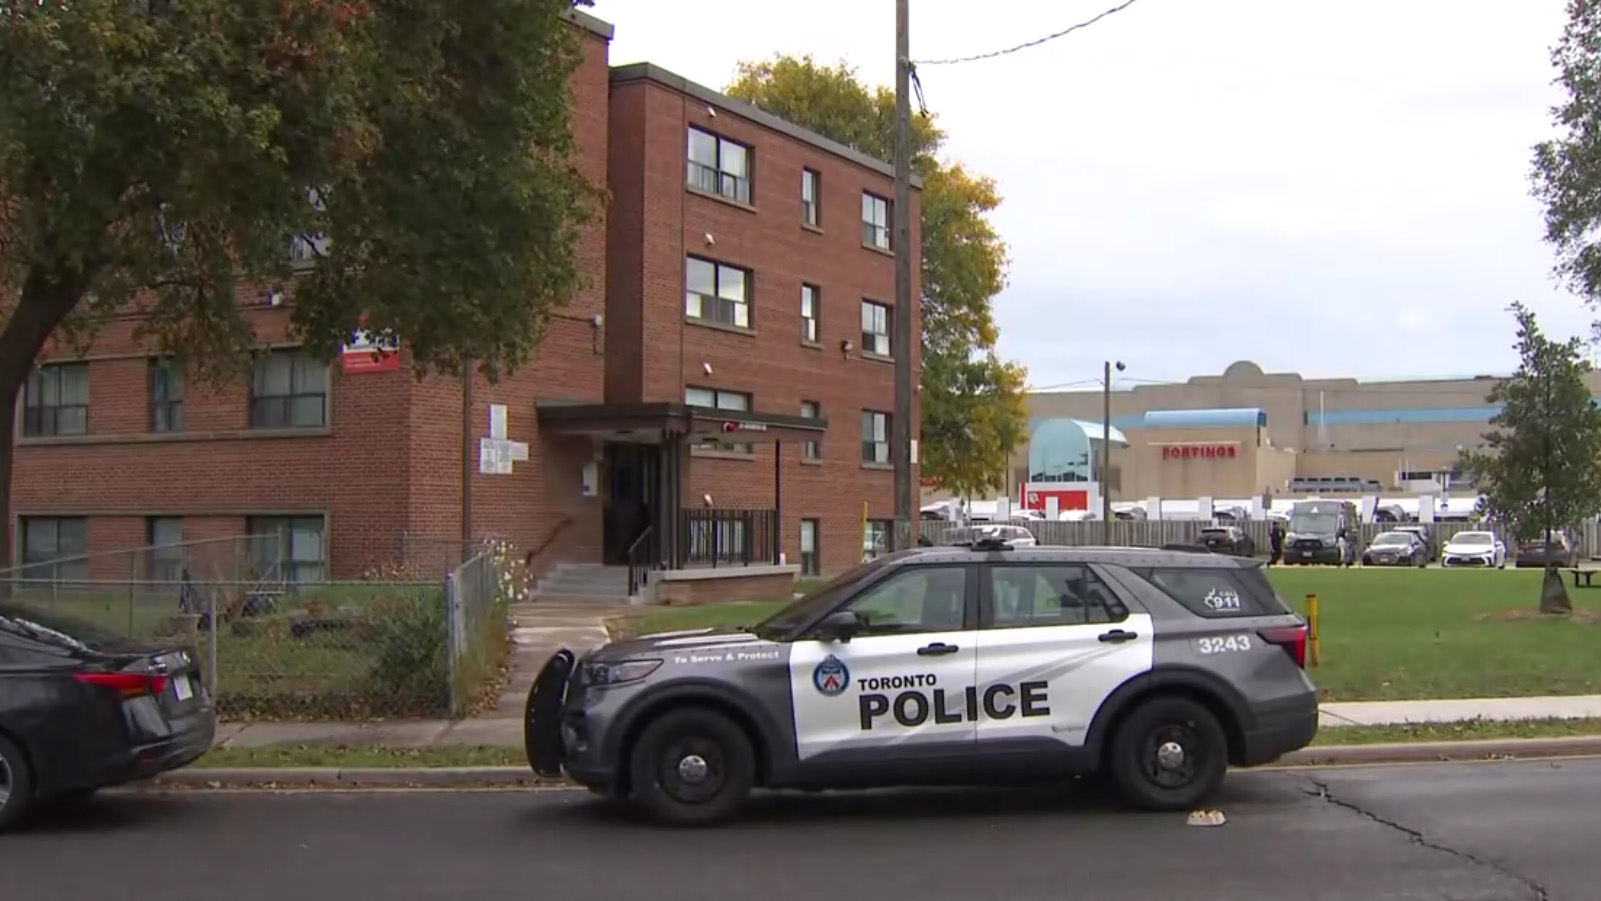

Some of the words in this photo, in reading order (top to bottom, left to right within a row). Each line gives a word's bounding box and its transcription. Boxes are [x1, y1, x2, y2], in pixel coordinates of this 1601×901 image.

[1213, 595, 1240, 608] 911
[1199, 634, 1251, 654] 3243
[674, 656, 688, 664] To
[690, 655, 723, 663] Serve
[725, 652, 735, 661] &
[738, 651, 780, 660] Protect
[857, 673, 937, 691] TORONTO
[859, 681, 1050, 730] POLICE
